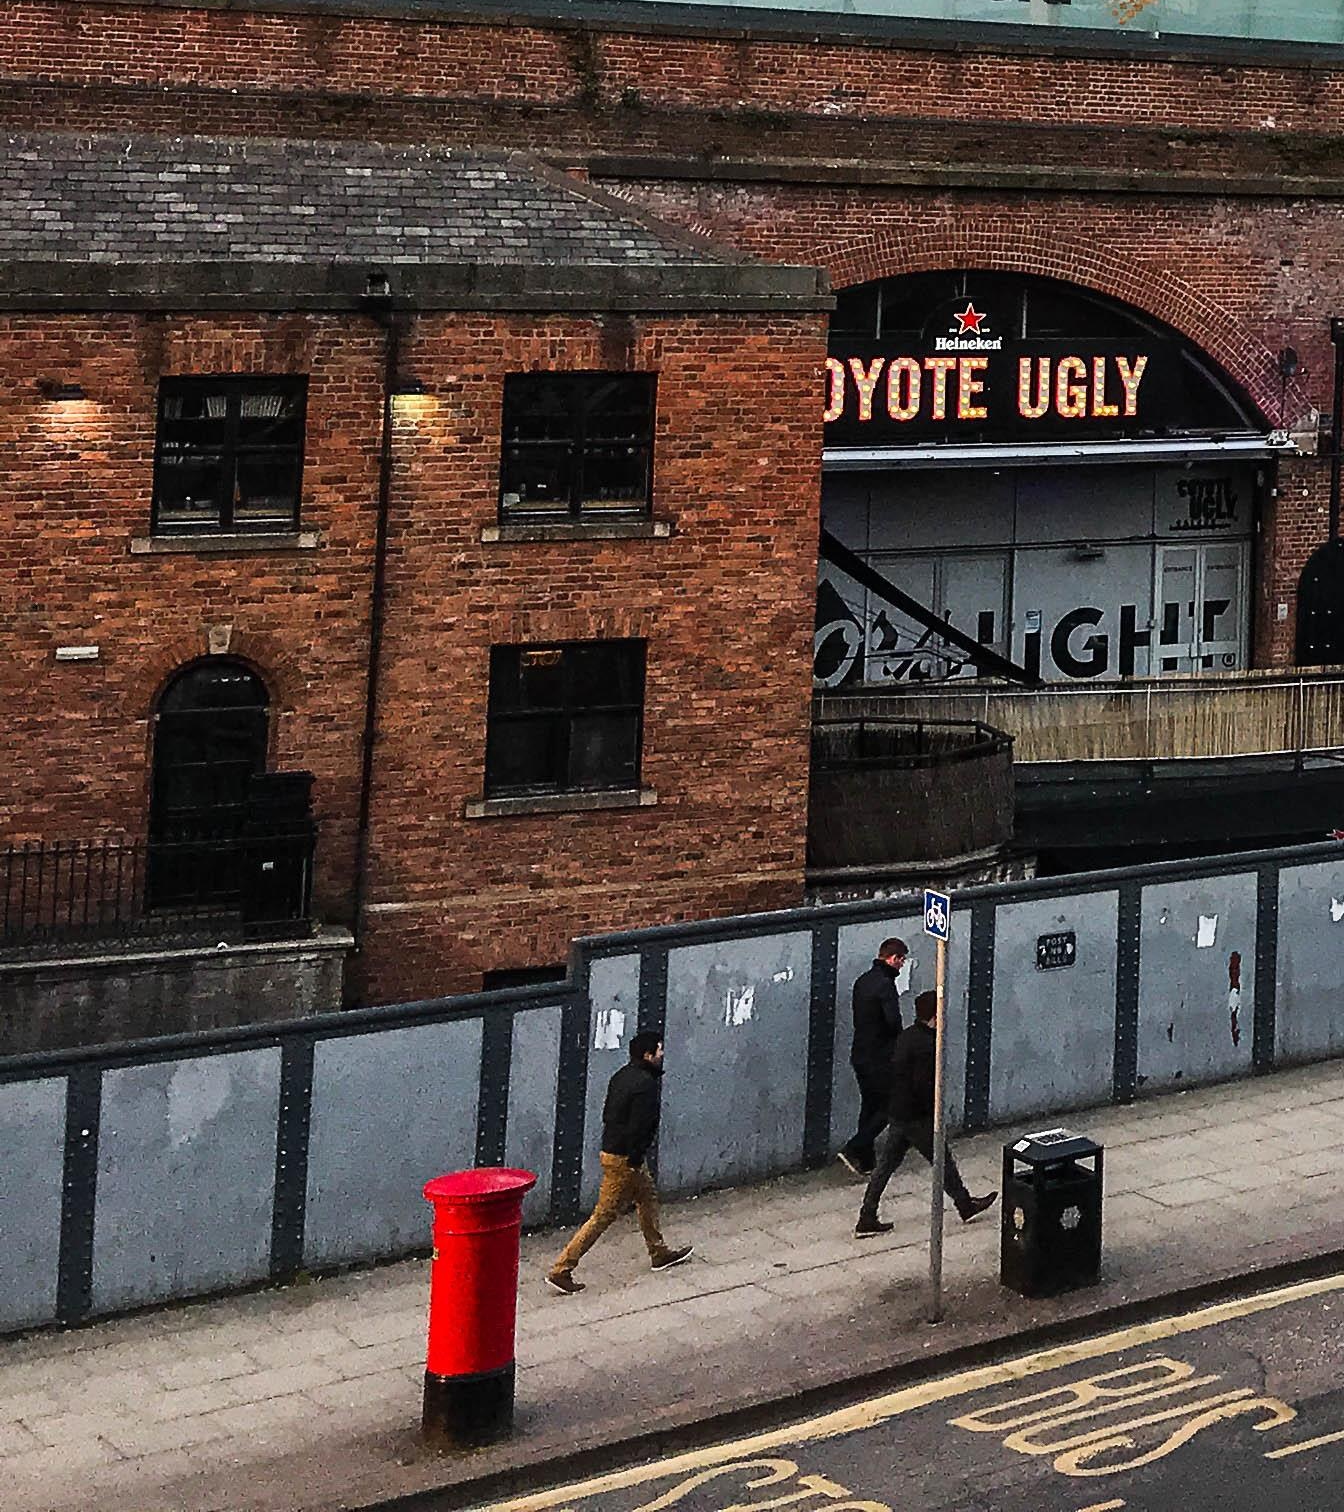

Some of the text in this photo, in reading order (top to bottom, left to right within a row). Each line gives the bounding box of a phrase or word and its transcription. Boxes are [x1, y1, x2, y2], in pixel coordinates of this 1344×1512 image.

[935, 337, 1001, 351] Heineken
[822, 355, 1149, 421] OYOTE UGLY
[947, 1355, 1297, 1478] BUS
